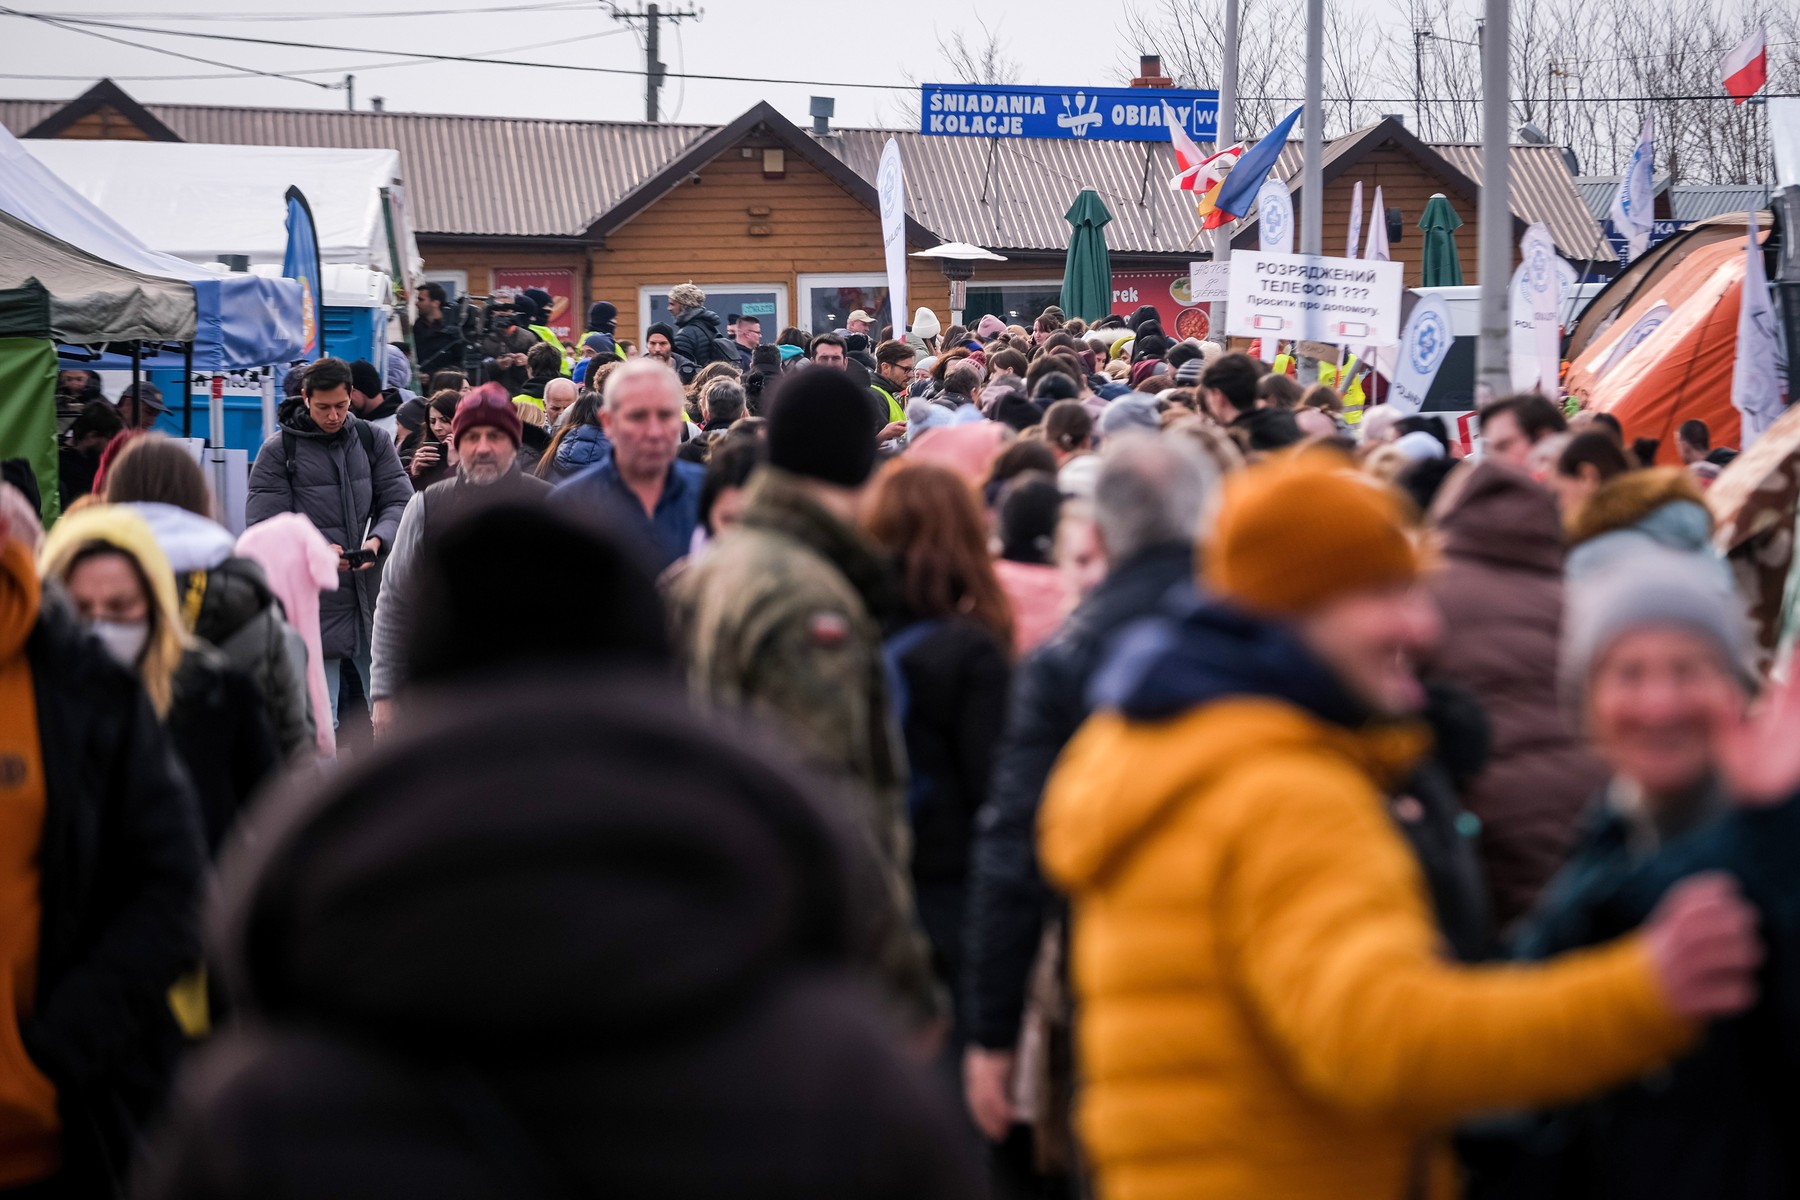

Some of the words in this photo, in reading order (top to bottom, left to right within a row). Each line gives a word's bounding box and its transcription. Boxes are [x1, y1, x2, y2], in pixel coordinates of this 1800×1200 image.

[929, 87, 1047, 115] ŚNIADANIA
[929, 114, 1023, 136] KOLACJE
[1194, 263, 1231, 276] АВТОБ
[1256, 261, 1377, 284] РОЗРЯДЖЕНИЙ
[1113, 286, 1139, 303] rek
[1261, 279, 1337, 297] ТЕЛЕФОН
[1341, 286, 1370, 300] ???
[1247, 294, 1296, 307] Просити
[1299, 301, 1321, 312] про
[1513, 319, 1536, 330] POL
